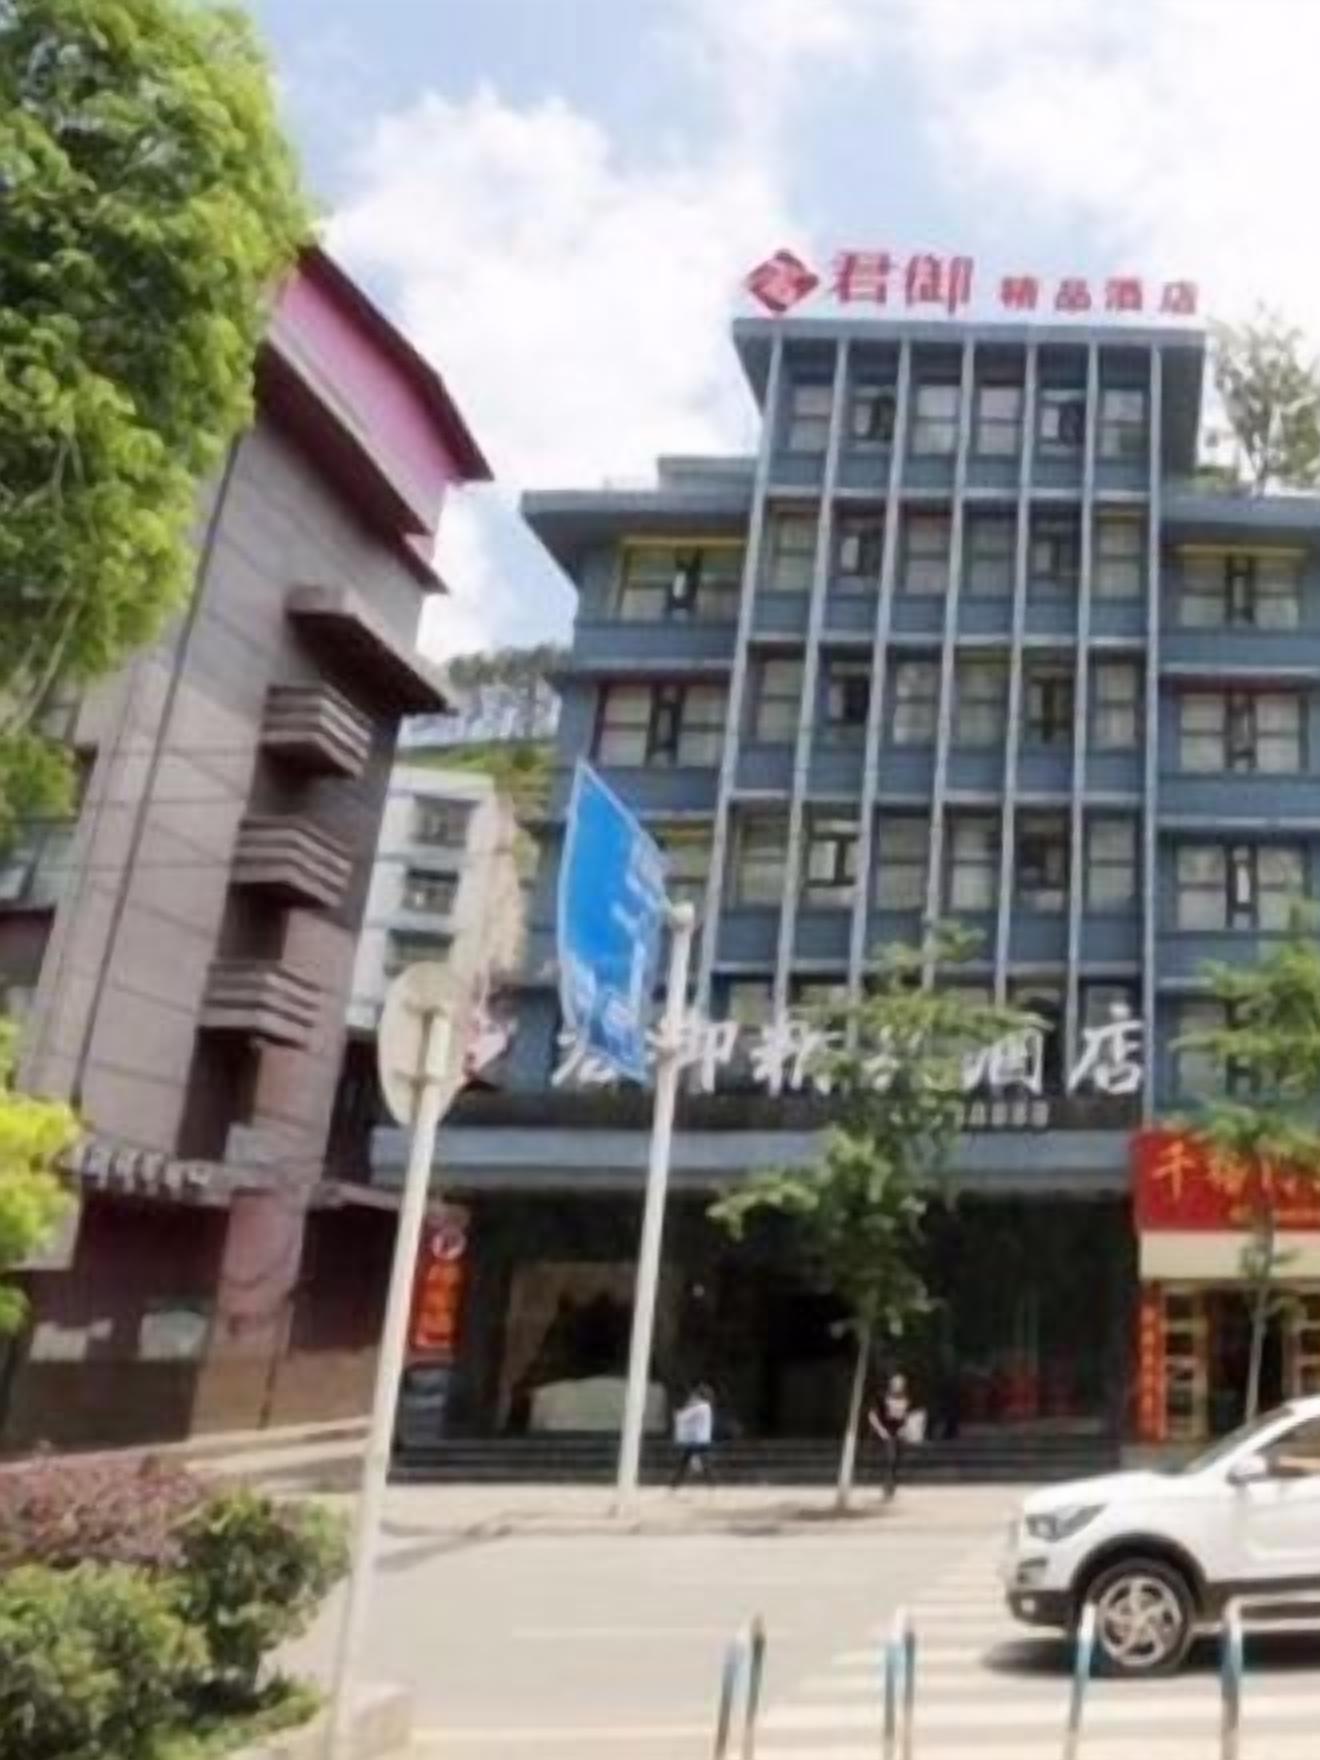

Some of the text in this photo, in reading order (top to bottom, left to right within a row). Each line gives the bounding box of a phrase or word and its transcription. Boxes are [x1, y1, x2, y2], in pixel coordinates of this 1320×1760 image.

[833, 252, 1198, 315] 君御 精品酒店
